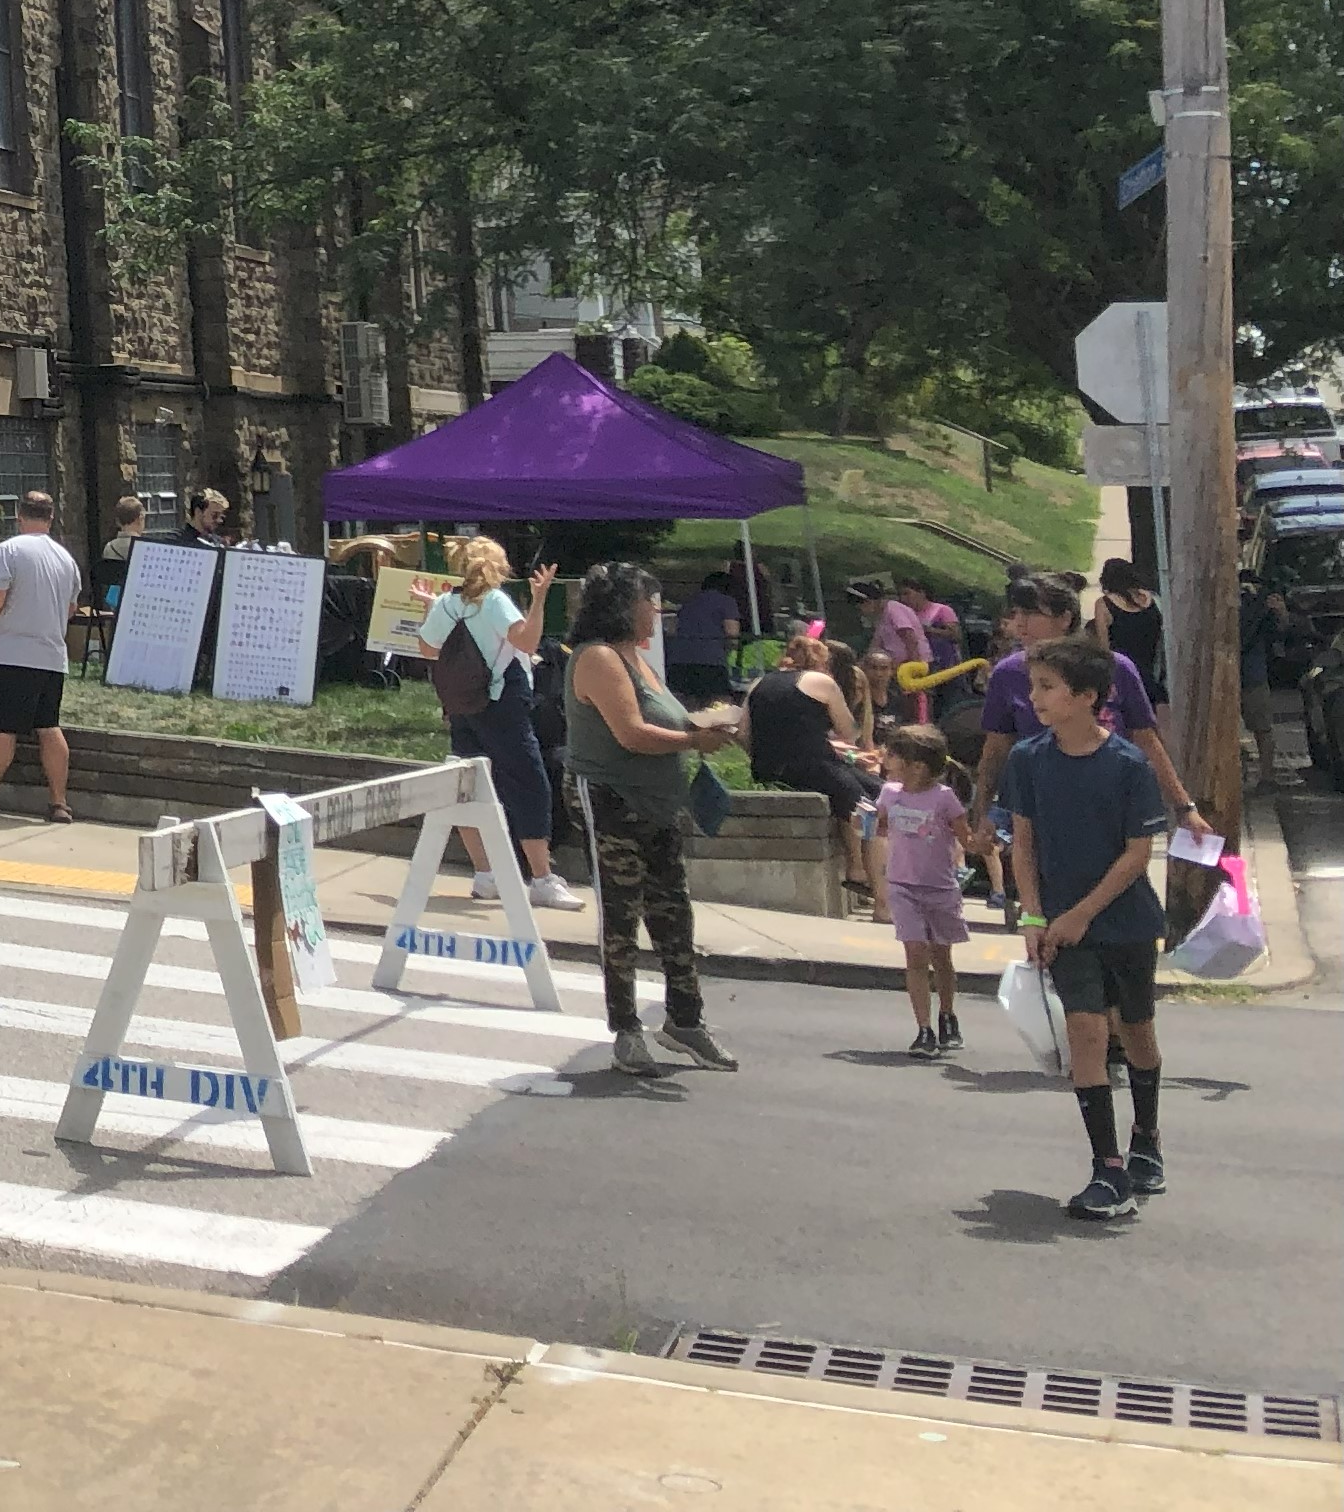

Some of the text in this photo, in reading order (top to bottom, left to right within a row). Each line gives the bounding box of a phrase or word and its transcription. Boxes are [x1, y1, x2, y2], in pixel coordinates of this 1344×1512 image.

[396, 927, 536, 968] 4TH DIV
[83, 1056, 269, 1114] 4TH DIV
